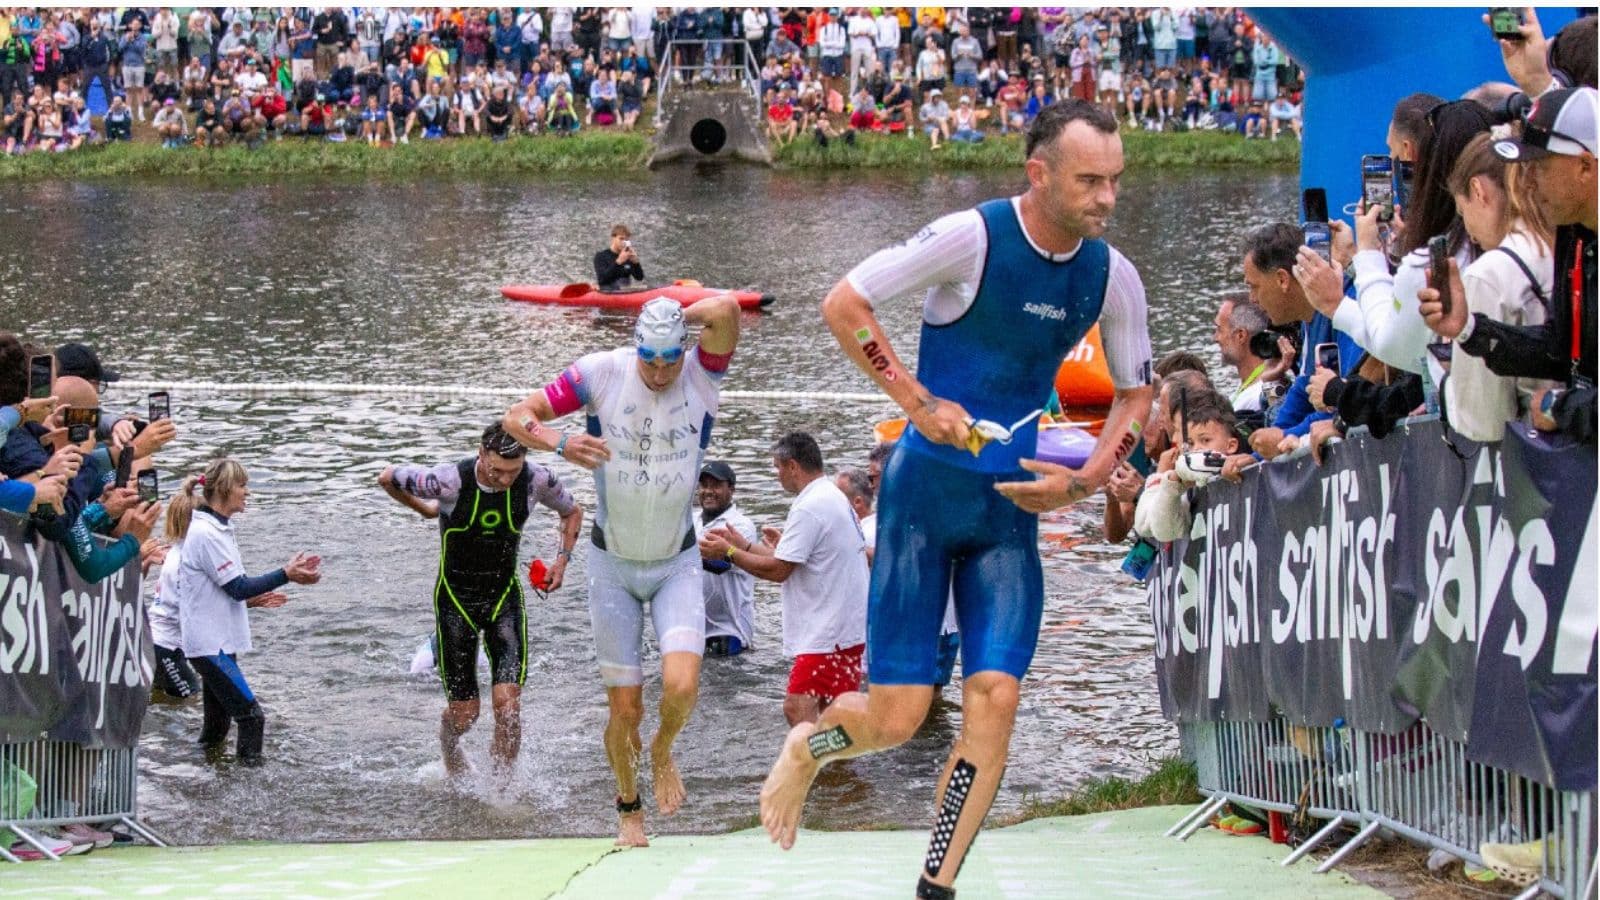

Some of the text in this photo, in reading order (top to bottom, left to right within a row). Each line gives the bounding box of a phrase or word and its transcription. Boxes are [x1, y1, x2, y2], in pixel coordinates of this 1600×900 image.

[1023, 302, 1067, 320] sailfish
[863, 340, 890, 372] 23
[161, 656, 191, 697] skinfit
